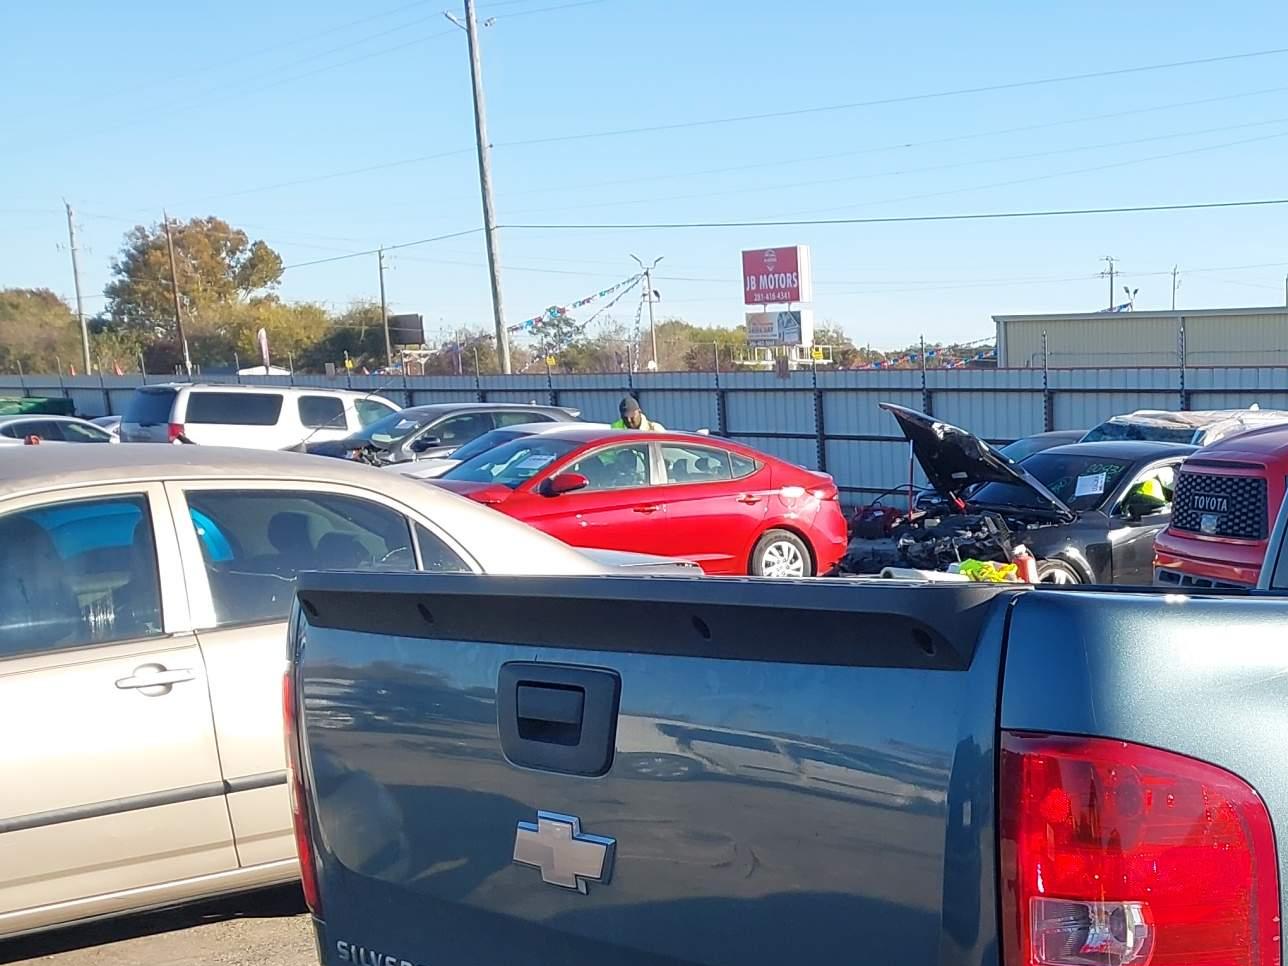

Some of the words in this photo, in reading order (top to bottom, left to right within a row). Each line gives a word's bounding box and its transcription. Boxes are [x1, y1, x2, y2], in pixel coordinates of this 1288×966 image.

[746, 275, 757, 291] JB
[759, 272, 798, 290] MOTORS
[1194, 495, 1228, 512] TOYOTA
